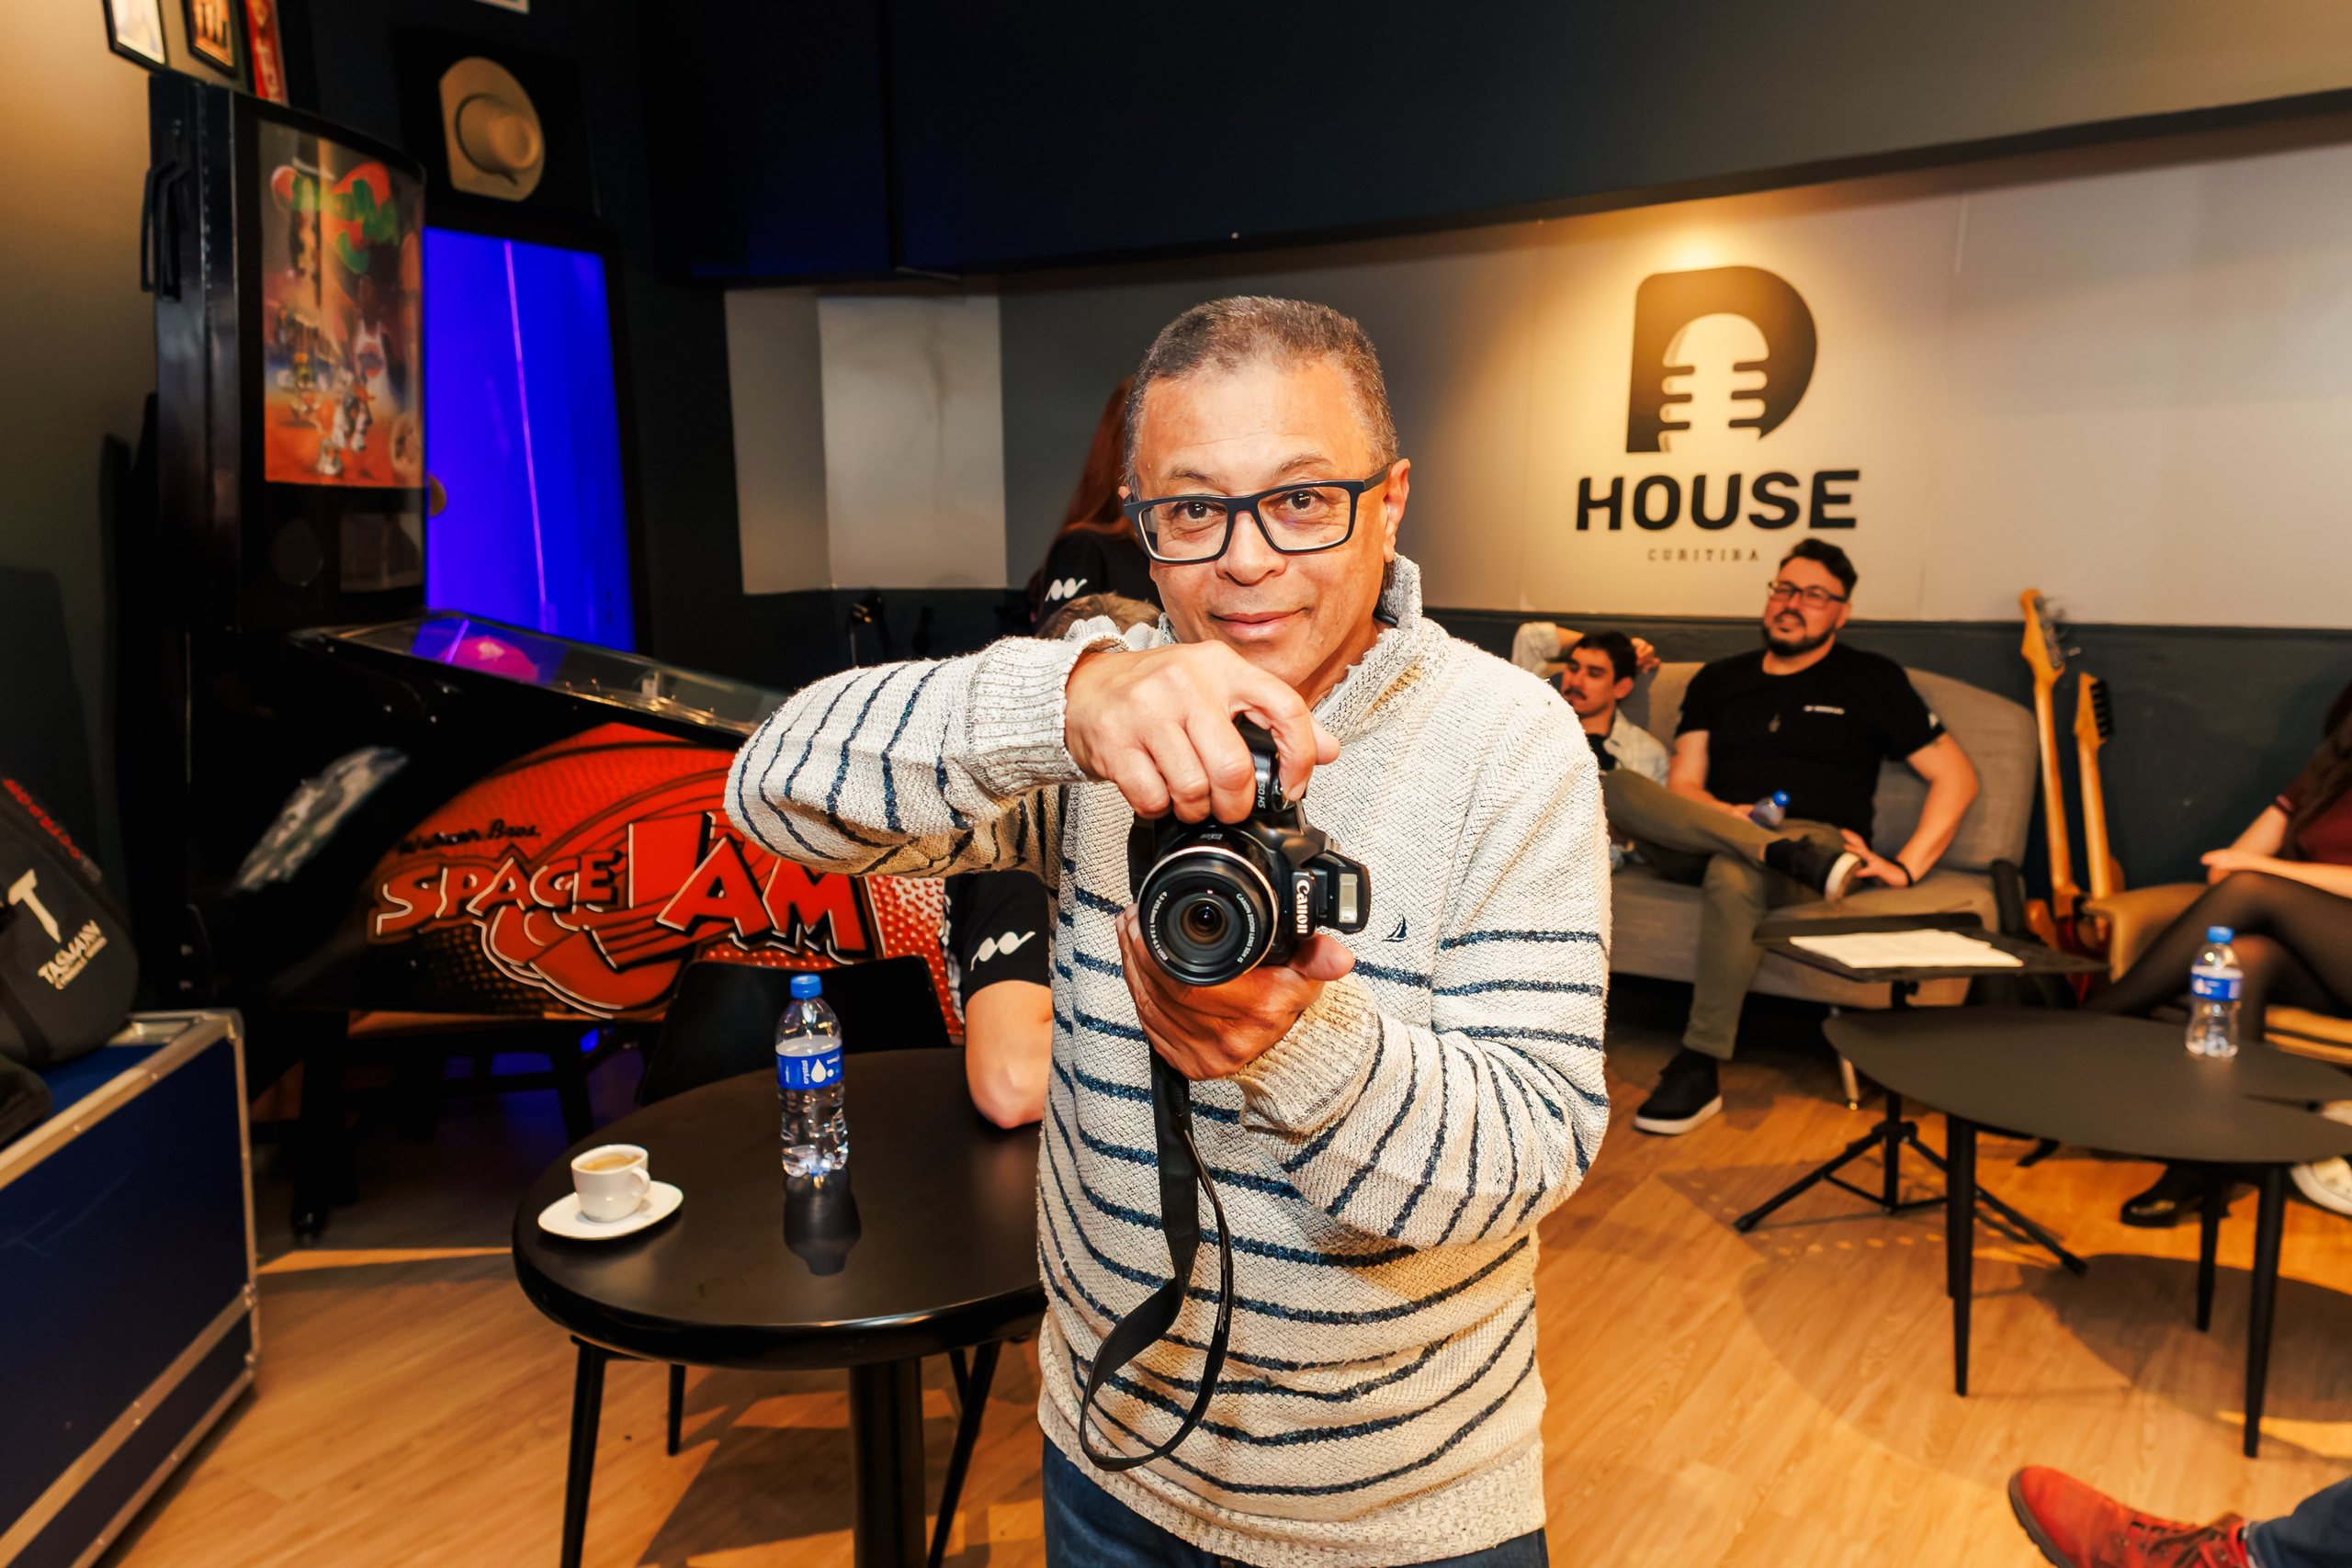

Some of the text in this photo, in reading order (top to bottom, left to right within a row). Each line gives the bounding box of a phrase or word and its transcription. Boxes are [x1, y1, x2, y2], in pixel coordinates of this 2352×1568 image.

[1577, 470, 1860, 530] HOUSE
[375, 854, 623, 938] SPACE
[1236, 893, 1251, 913] CANON
[1295, 879, 1310, 933] Canon
[1247, 914, 1255, 932] ZOOM
[1247, 932, 1255, 947] LENS
